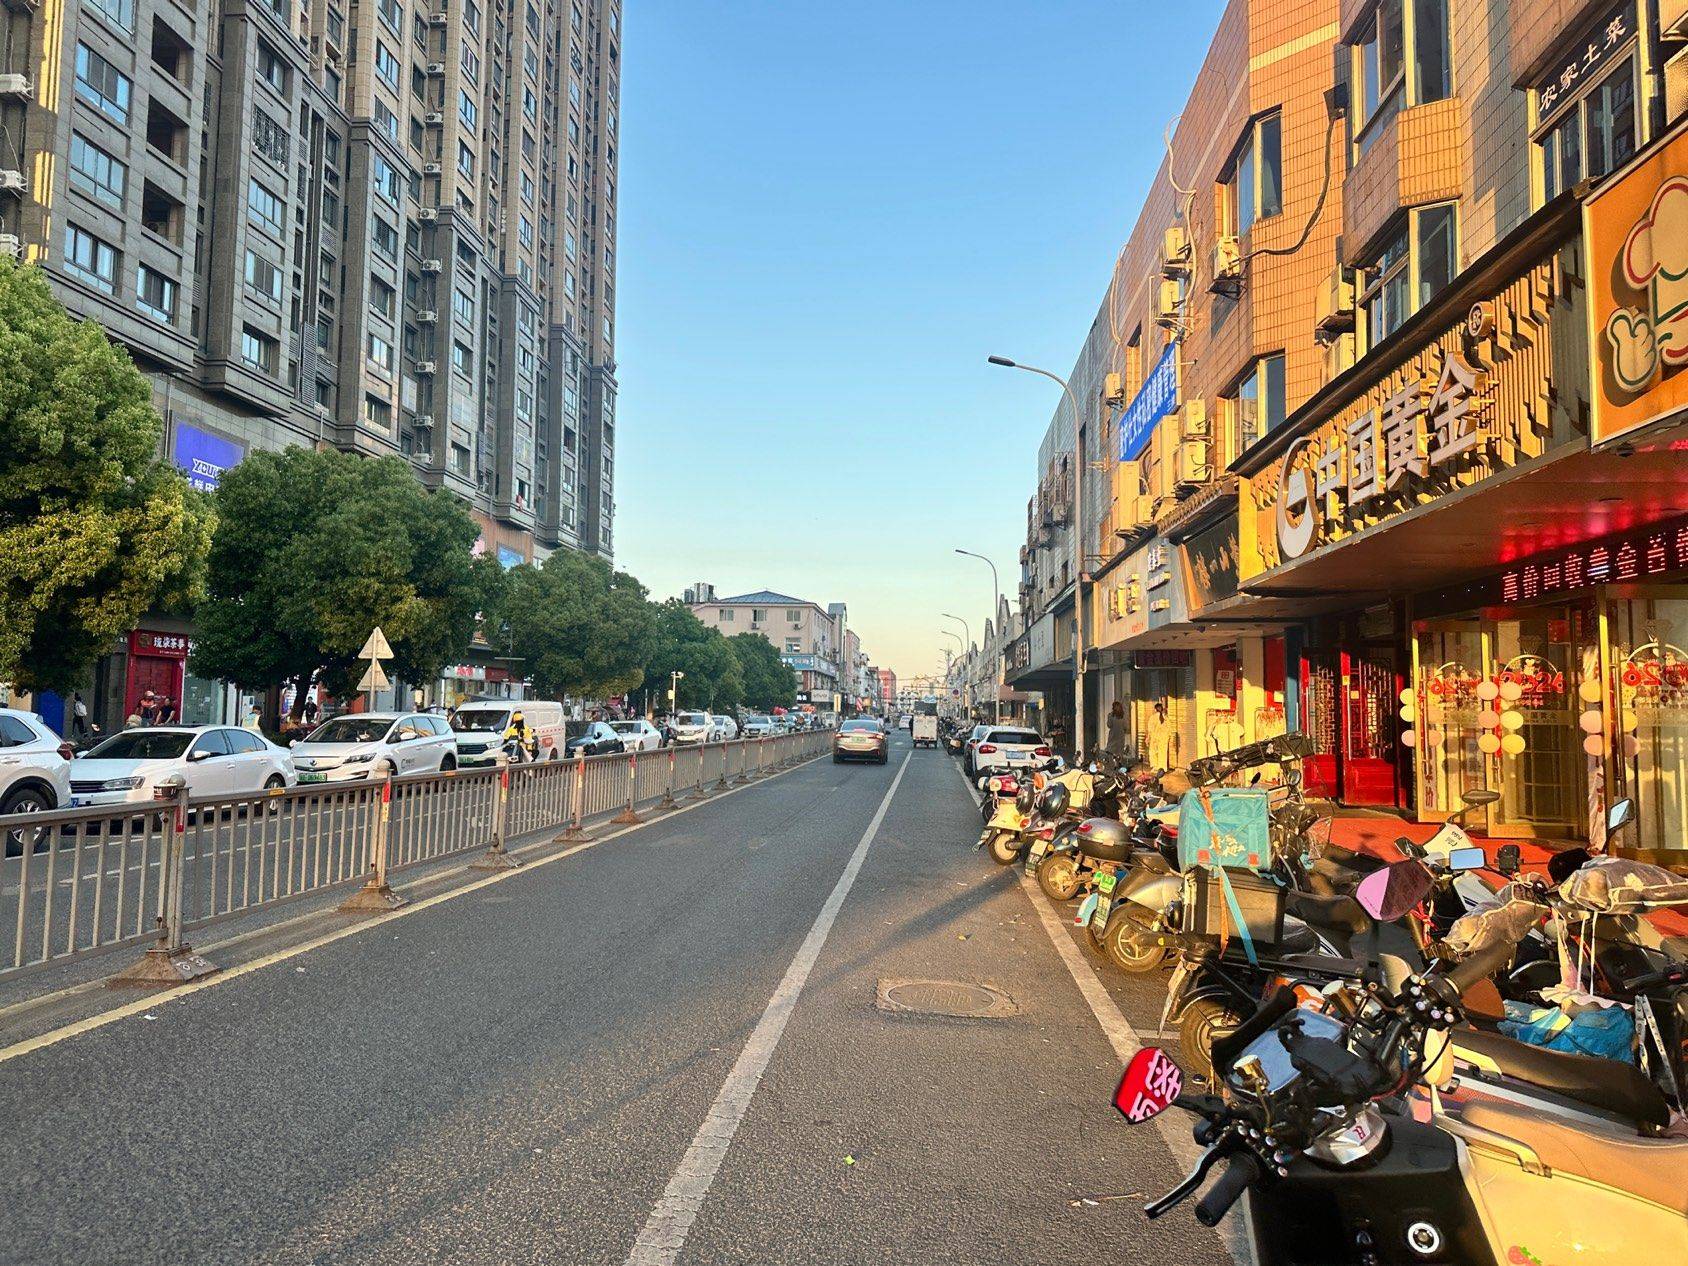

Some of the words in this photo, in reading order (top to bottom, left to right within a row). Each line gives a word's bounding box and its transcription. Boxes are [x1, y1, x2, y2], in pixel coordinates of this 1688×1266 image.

[1539, 15, 1627, 112] 农家土菜
[1316, 351, 1483, 521] 中国黄金
